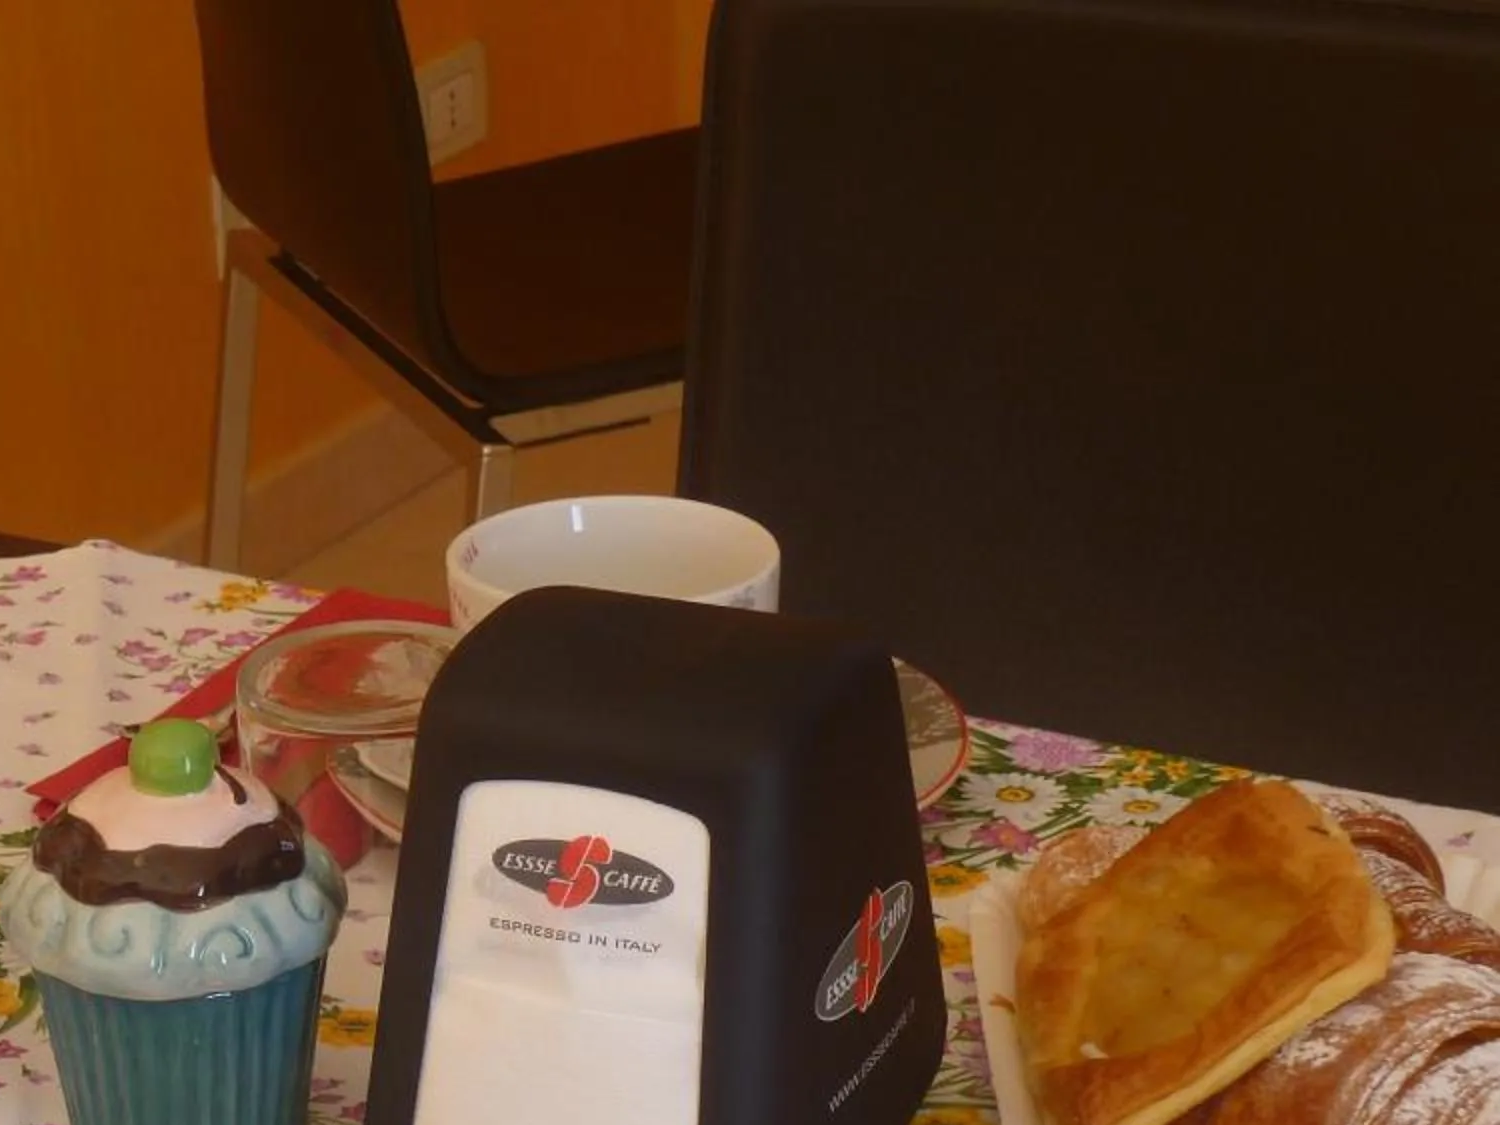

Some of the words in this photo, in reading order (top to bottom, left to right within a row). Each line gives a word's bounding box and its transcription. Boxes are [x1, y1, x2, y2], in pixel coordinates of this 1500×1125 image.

[502, 853, 557, 876] ESSSE
[490, 917, 581, 943] ESPRESSO
[588, 934, 607, 948] IN
[615, 938, 662, 954] ITALY
